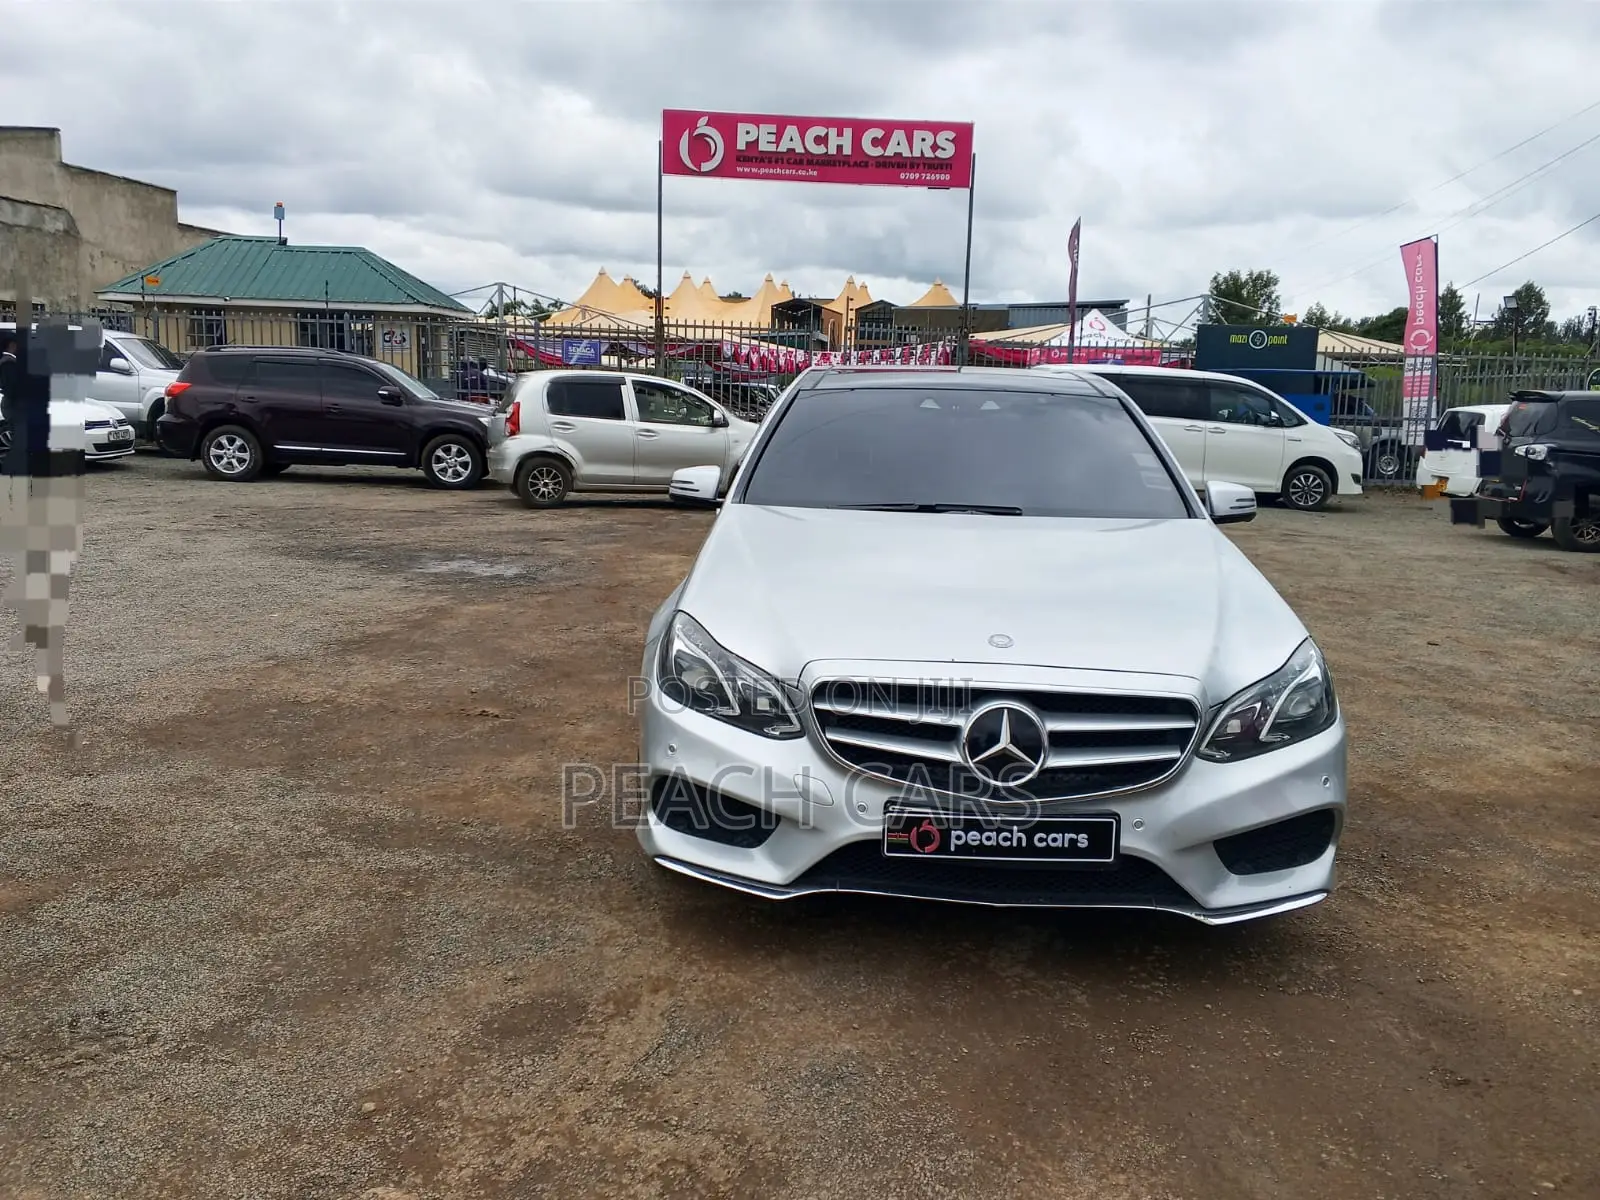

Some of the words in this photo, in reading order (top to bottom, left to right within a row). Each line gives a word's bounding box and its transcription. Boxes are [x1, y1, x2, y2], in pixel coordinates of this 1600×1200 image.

[736, 122, 853, 156] PEACH
[861, 127, 957, 159] CARS
[875, 160, 907, 170] DRIVEN
[736, 166, 818, 177] www.peachcars.co.ke
[899, 172, 920, 181] 0709
[950, 826, 1027, 851] peach
[1033, 830, 1089, 849] cars
